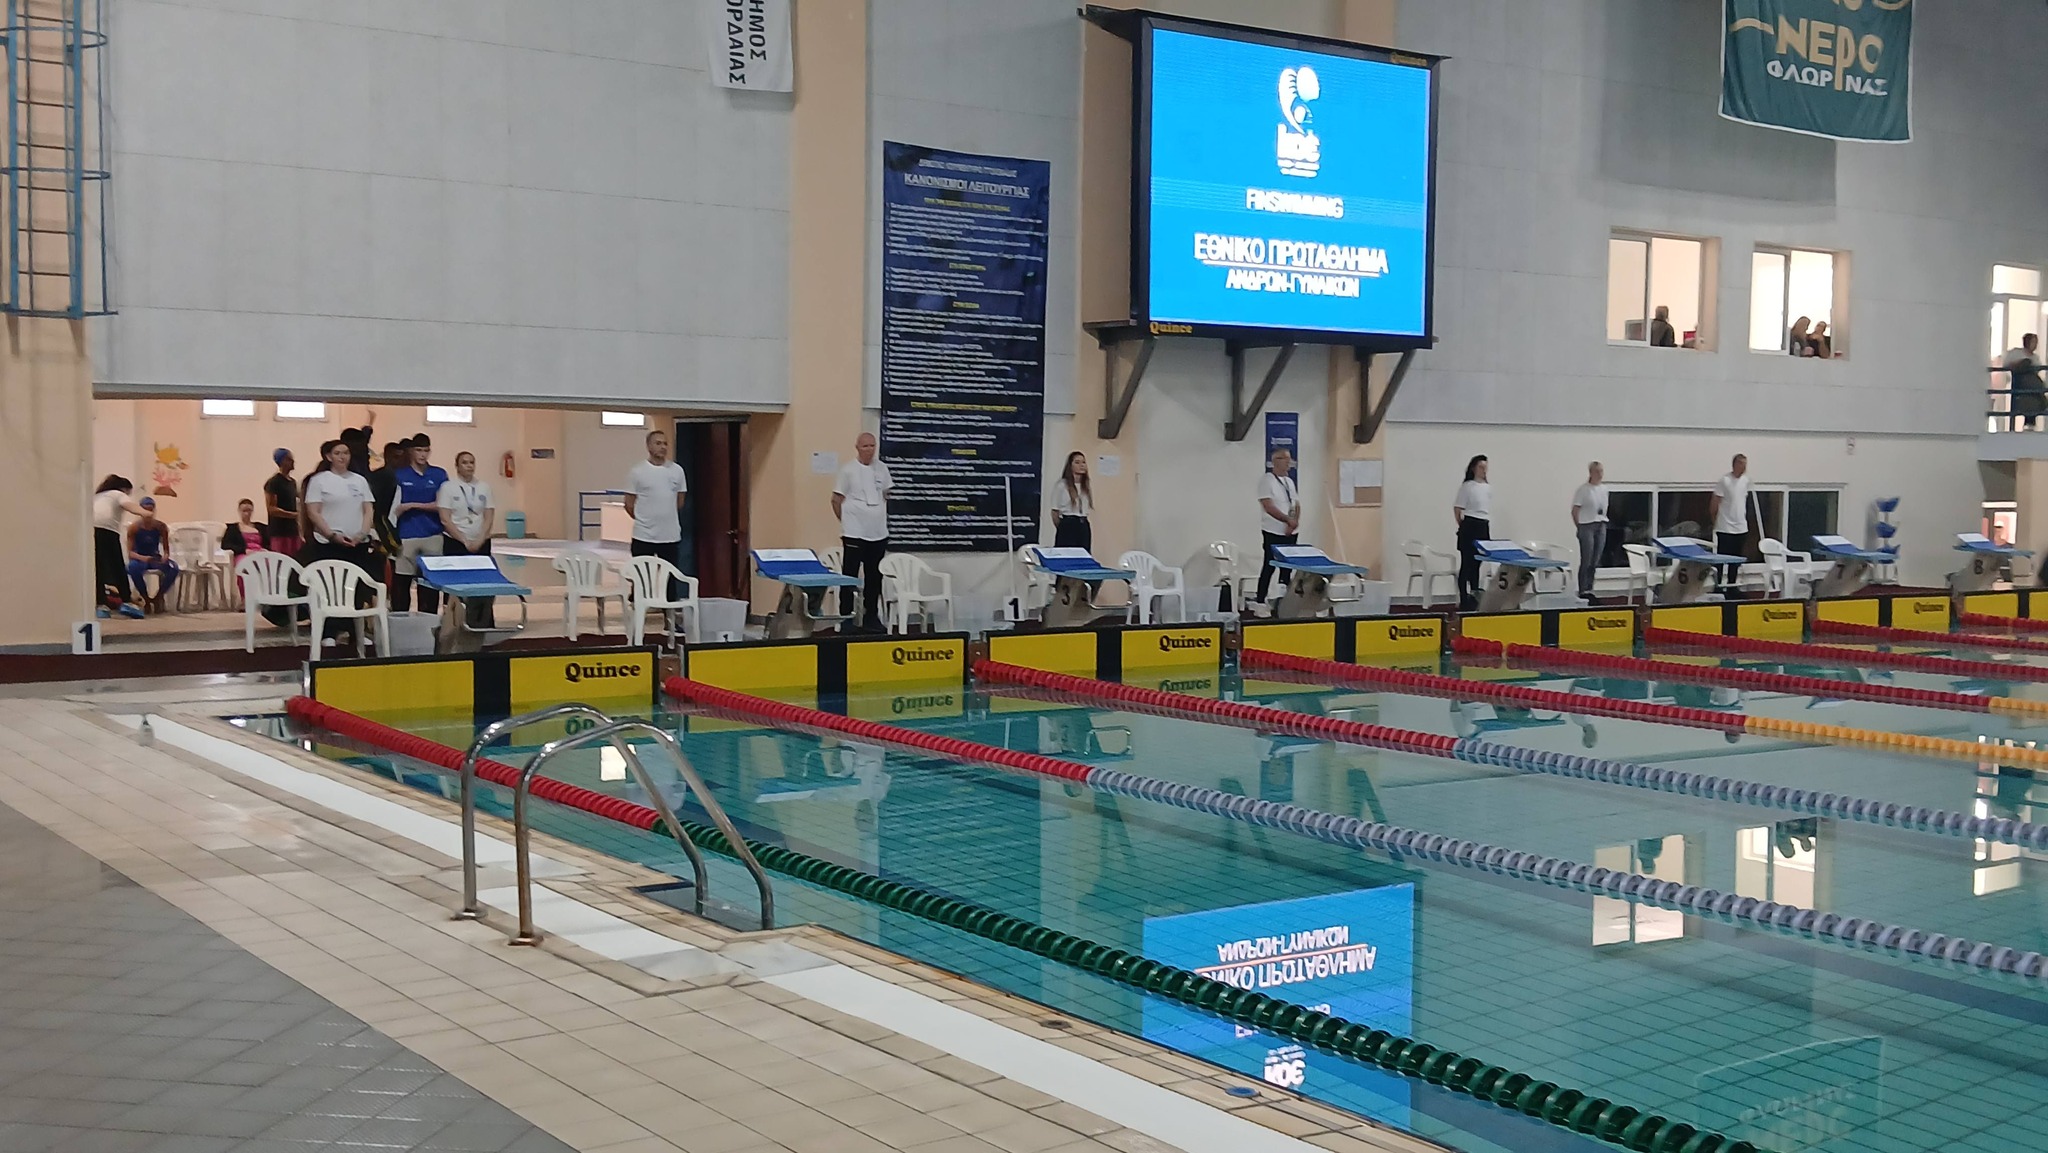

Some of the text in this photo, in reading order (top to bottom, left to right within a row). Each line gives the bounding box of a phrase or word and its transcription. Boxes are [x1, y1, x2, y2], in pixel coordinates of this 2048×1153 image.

[749, 0, 766, 60] ΗΜΟΣ
[1194, 233, 1390, 274] ΕΘΝΙΚΟ ΠΡΩΤΑΘΛΗΜΑ
[1150, 322, 1193, 335] Quince
[1678, 568, 1689, 584] 6
[1836, 563, 1846, 580] 7
[1974, 559, 1983, 575] 8
[1498, 572, 1509, 590] 5
[1061, 585, 1071, 605] 3
[1008, 597, 1019, 619] 1
[78, 623, 93, 652] 1
[1389, 625, 1434, 641] Quince
[1159, 635, 1211, 652] Quince
[892, 647, 954, 665] Quince
[565, 662, 640, 683] Quince
